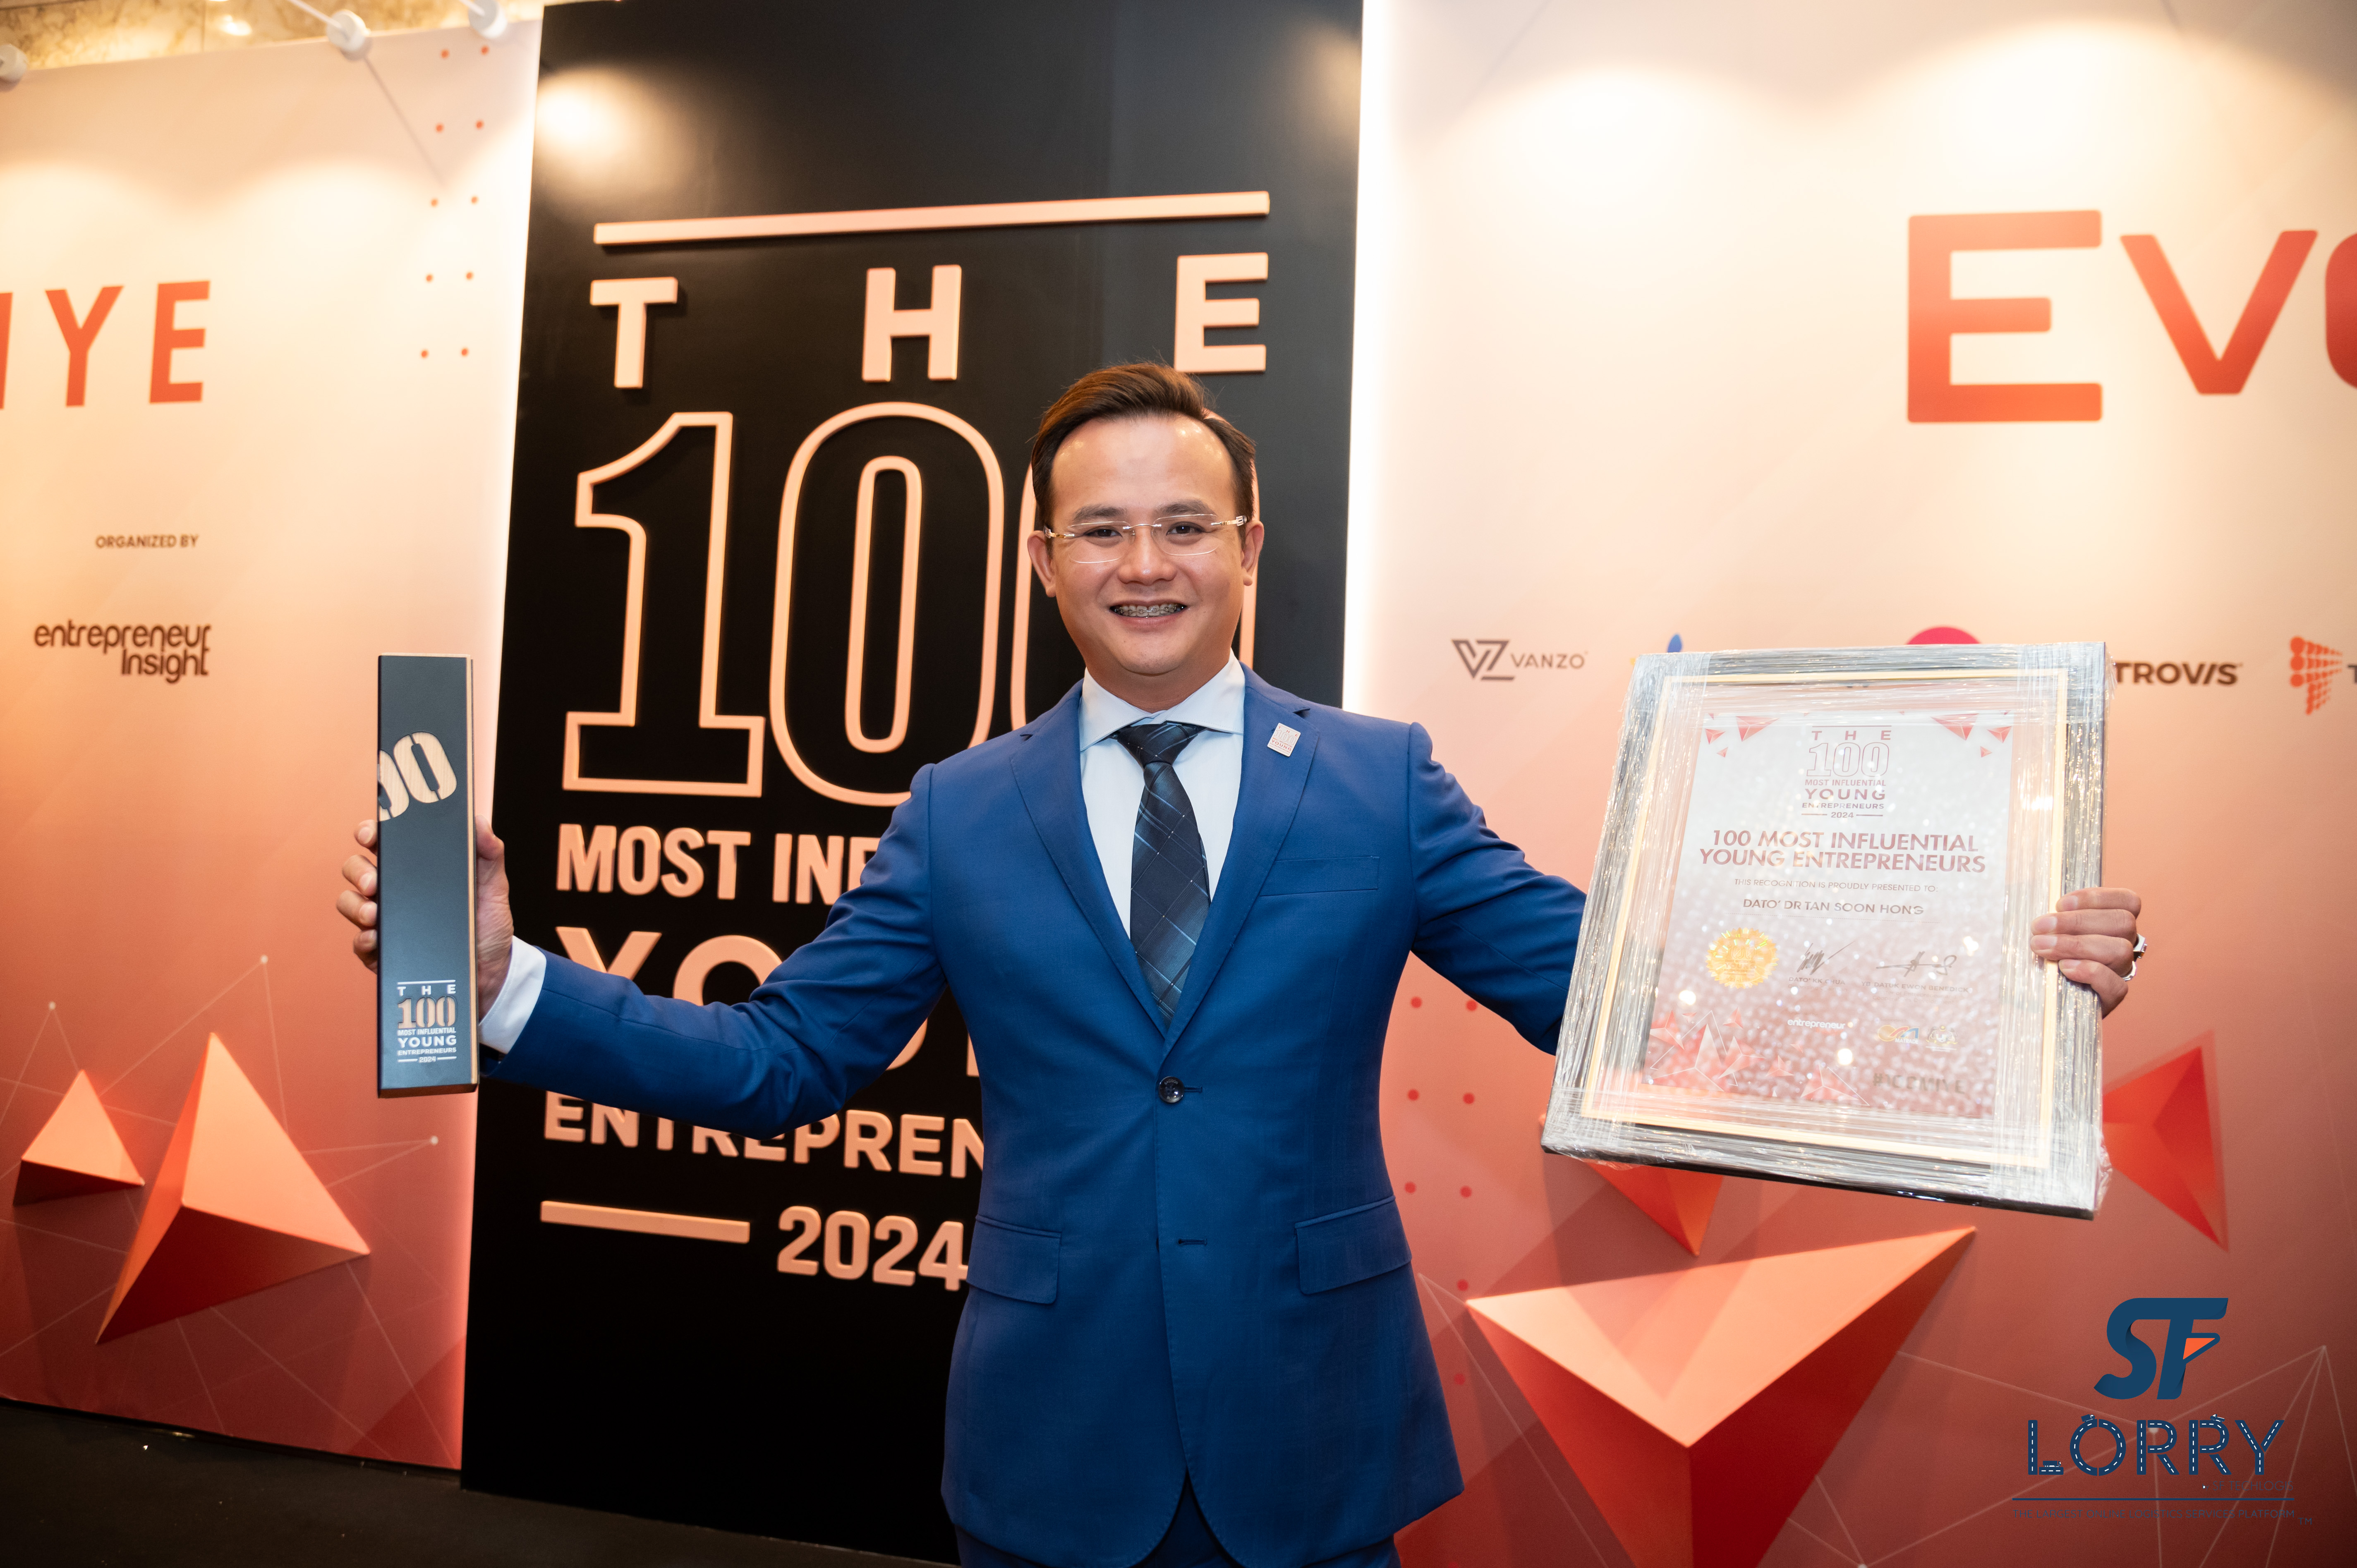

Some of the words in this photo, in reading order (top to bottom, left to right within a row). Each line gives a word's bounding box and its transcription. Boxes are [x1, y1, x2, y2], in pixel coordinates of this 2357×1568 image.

[589, 252, 1269, 389] THE
[95, 534, 177, 548] ORGANIZED
[180, 534, 199, 548] BY
[34, 619, 211, 654] entrepreneur
[1511, 653, 1585, 669] VANZO
[2115, 661, 2238, 685] TROVIS
[1274, 730, 1296, 745] 100
[1811, 730, 1892, 740] THE
[1272, 740, 1291, 751] YOUNG
[1806, 742, 1889, 777] 100
[1805, 788, 1885, 800] YOUNG
[1713, 830, 1751, 846] 100
[1758, 831, 1824, 848] MOST
[1831, 832, 1979, 852] INFLUENTIAL
[556, 823, 751, 900] MOST
[1700, 848, 1785, 867] YOUNG
[1792, 850, 1986, 873] ENTREPRENEURS
[1754, 879, 1816, 888] RECOGNITION
[1784, 900, 1801, 910] DR
[1805, 901, 1830, 911] TAN
[1834, 902, 1875, 913] SOON
[1880, 904, 1924, 915] HONG
[397, 984, 456, 996] THE
[398, 996, 456, 1029] 100
[1787, 1019, 1845, 1029] entrepreneur
[398, 1035, 457, 1048] YOUNG
[398, 1047, 457, 1056] ENTREPRENEURS
[777, 1206, 968, 1291] 2024
